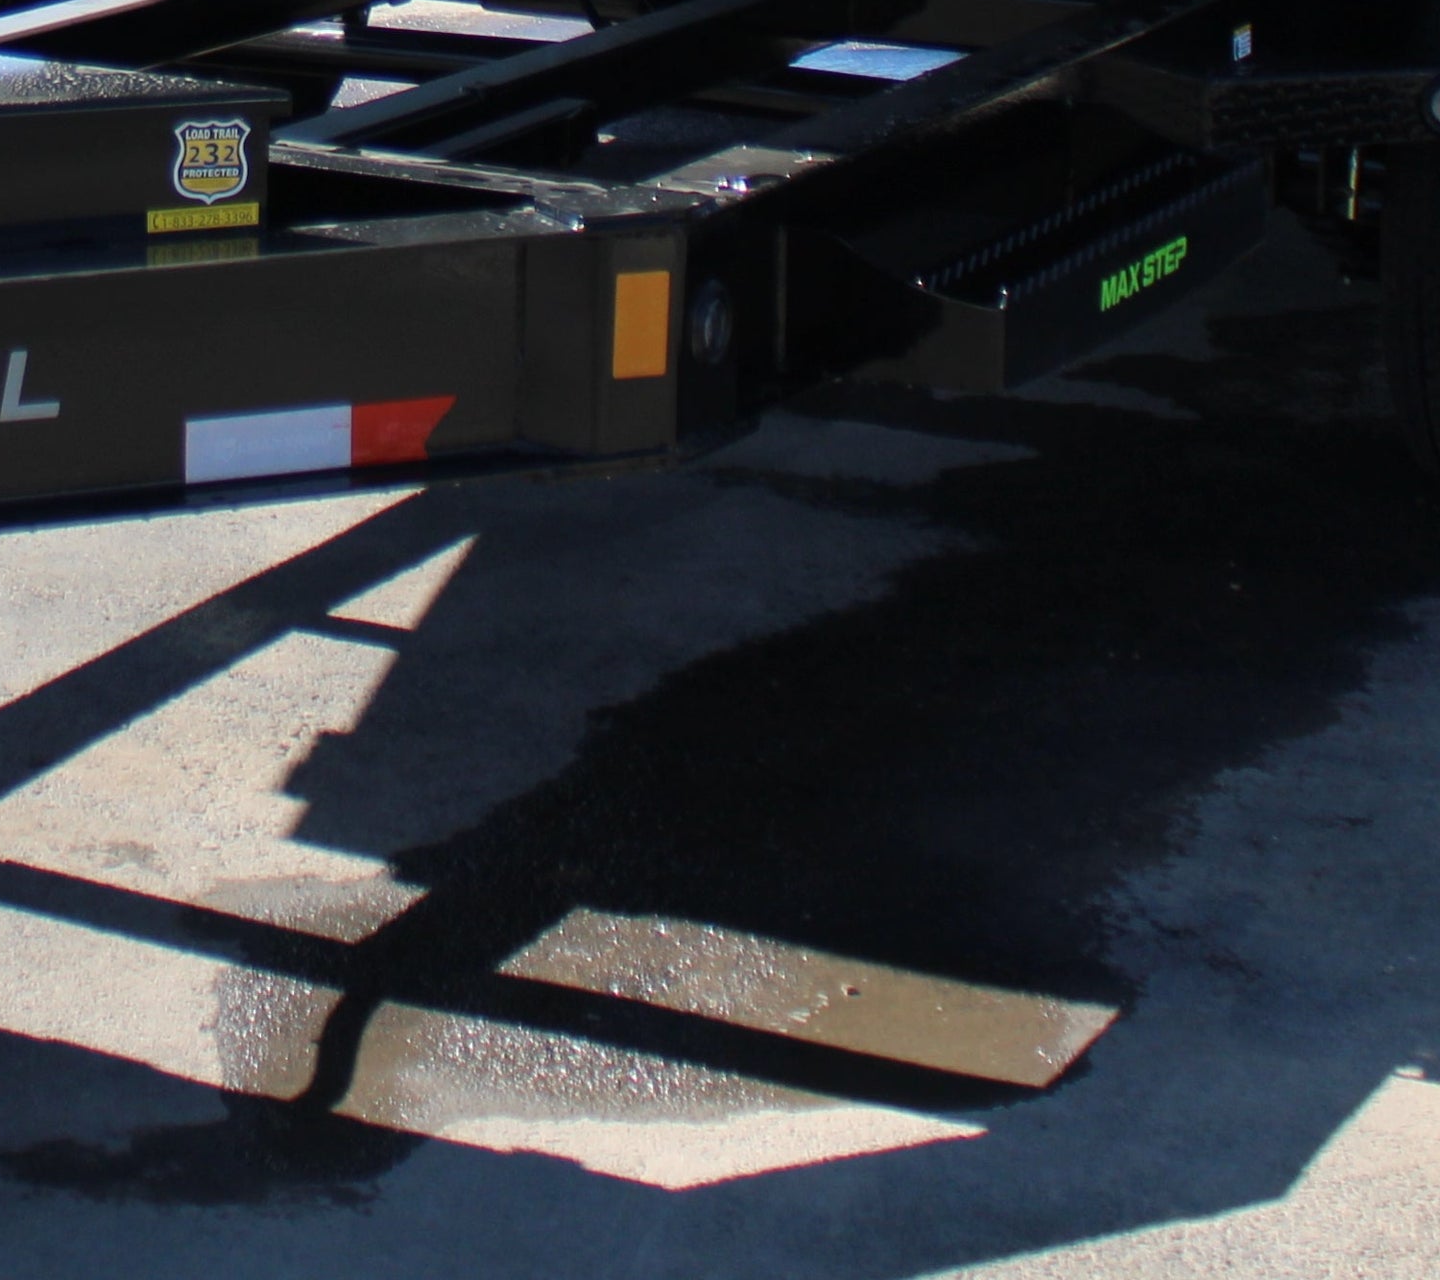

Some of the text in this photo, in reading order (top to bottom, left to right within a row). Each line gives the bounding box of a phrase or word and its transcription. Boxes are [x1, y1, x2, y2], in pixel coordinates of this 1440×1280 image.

[185, 127, 241, 140] LOAD TRAIL
[182, 168, 240, 178] PROTECTED
[1101, 236, 1187, 312] MAX STEP
